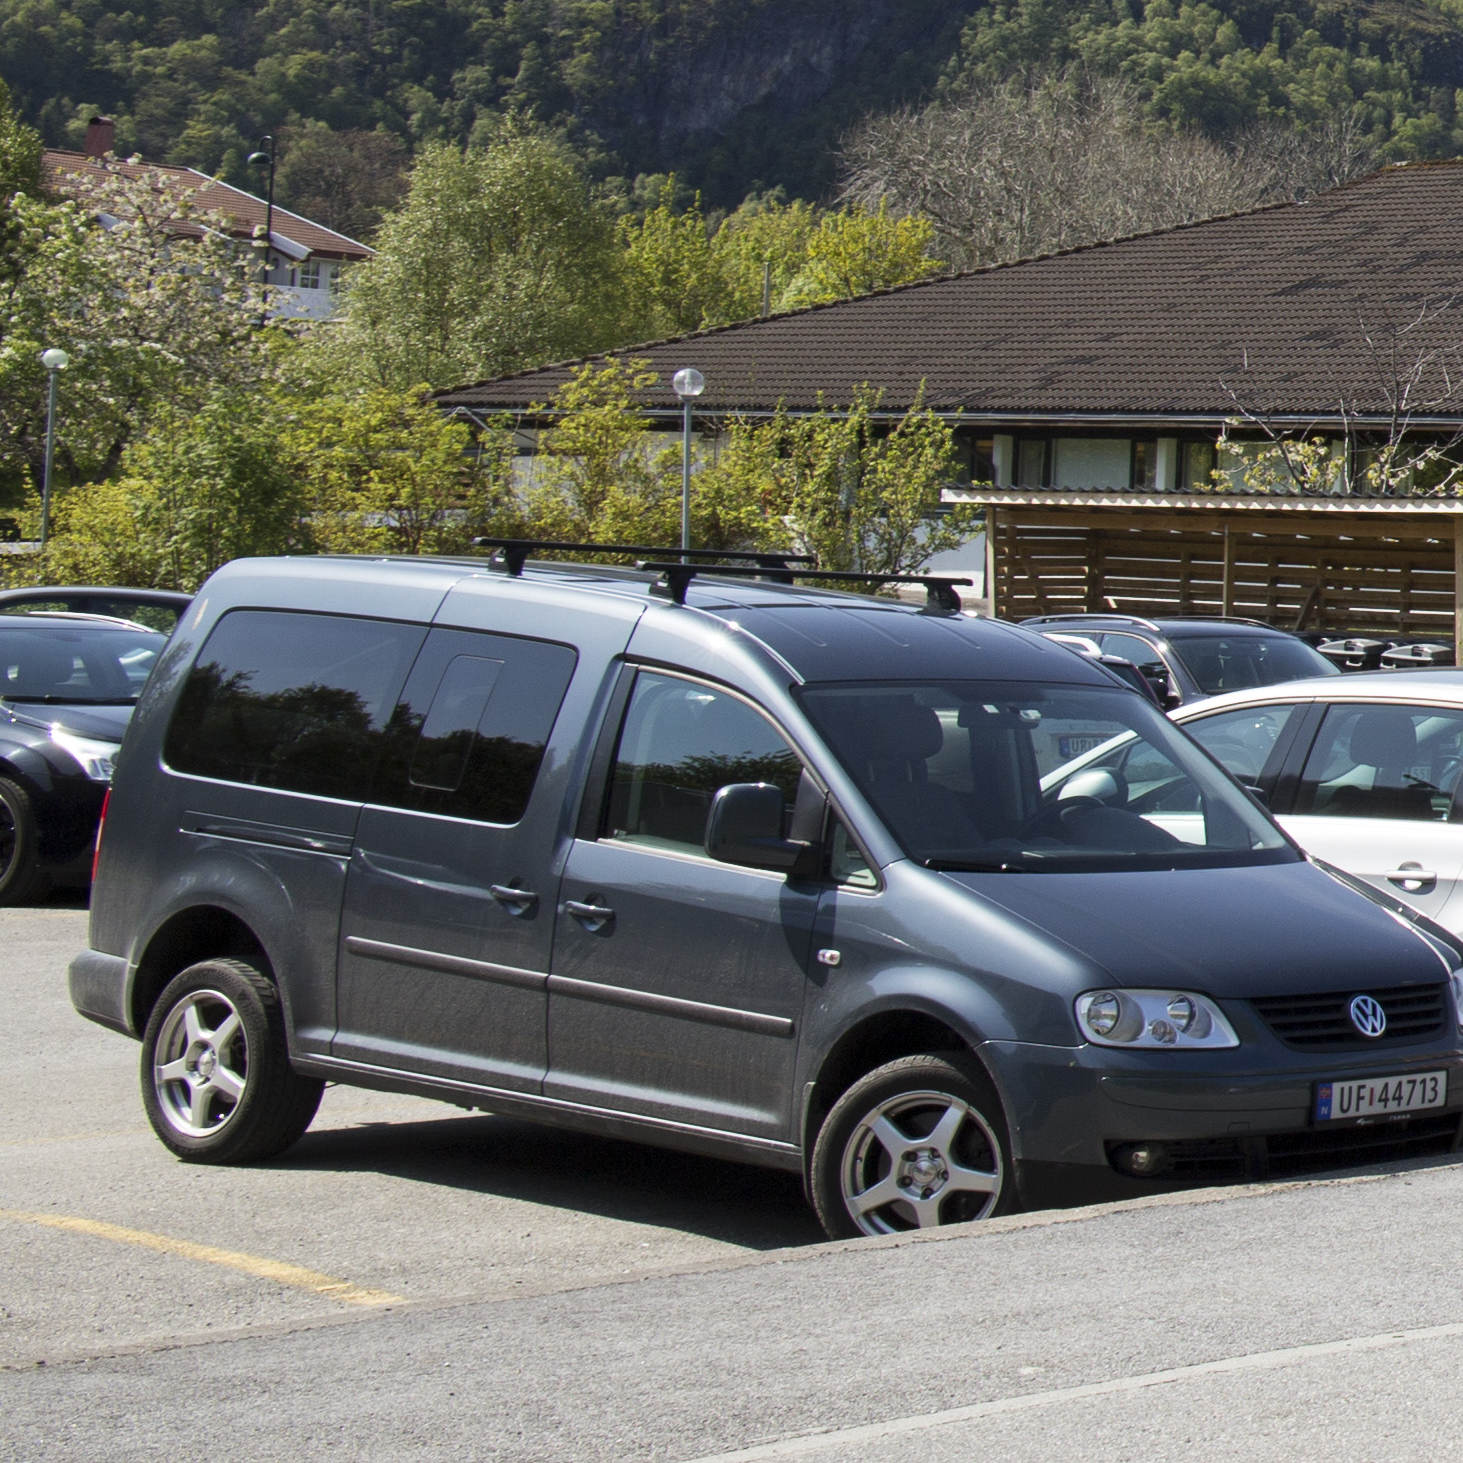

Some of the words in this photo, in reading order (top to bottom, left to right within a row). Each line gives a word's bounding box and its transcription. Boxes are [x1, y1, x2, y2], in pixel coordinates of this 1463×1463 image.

[1339, 1084, 1366, 1114] UF
[1377, 1076, 1439, 1109] 44713
[1321, 1106, 1328, 1114] N
